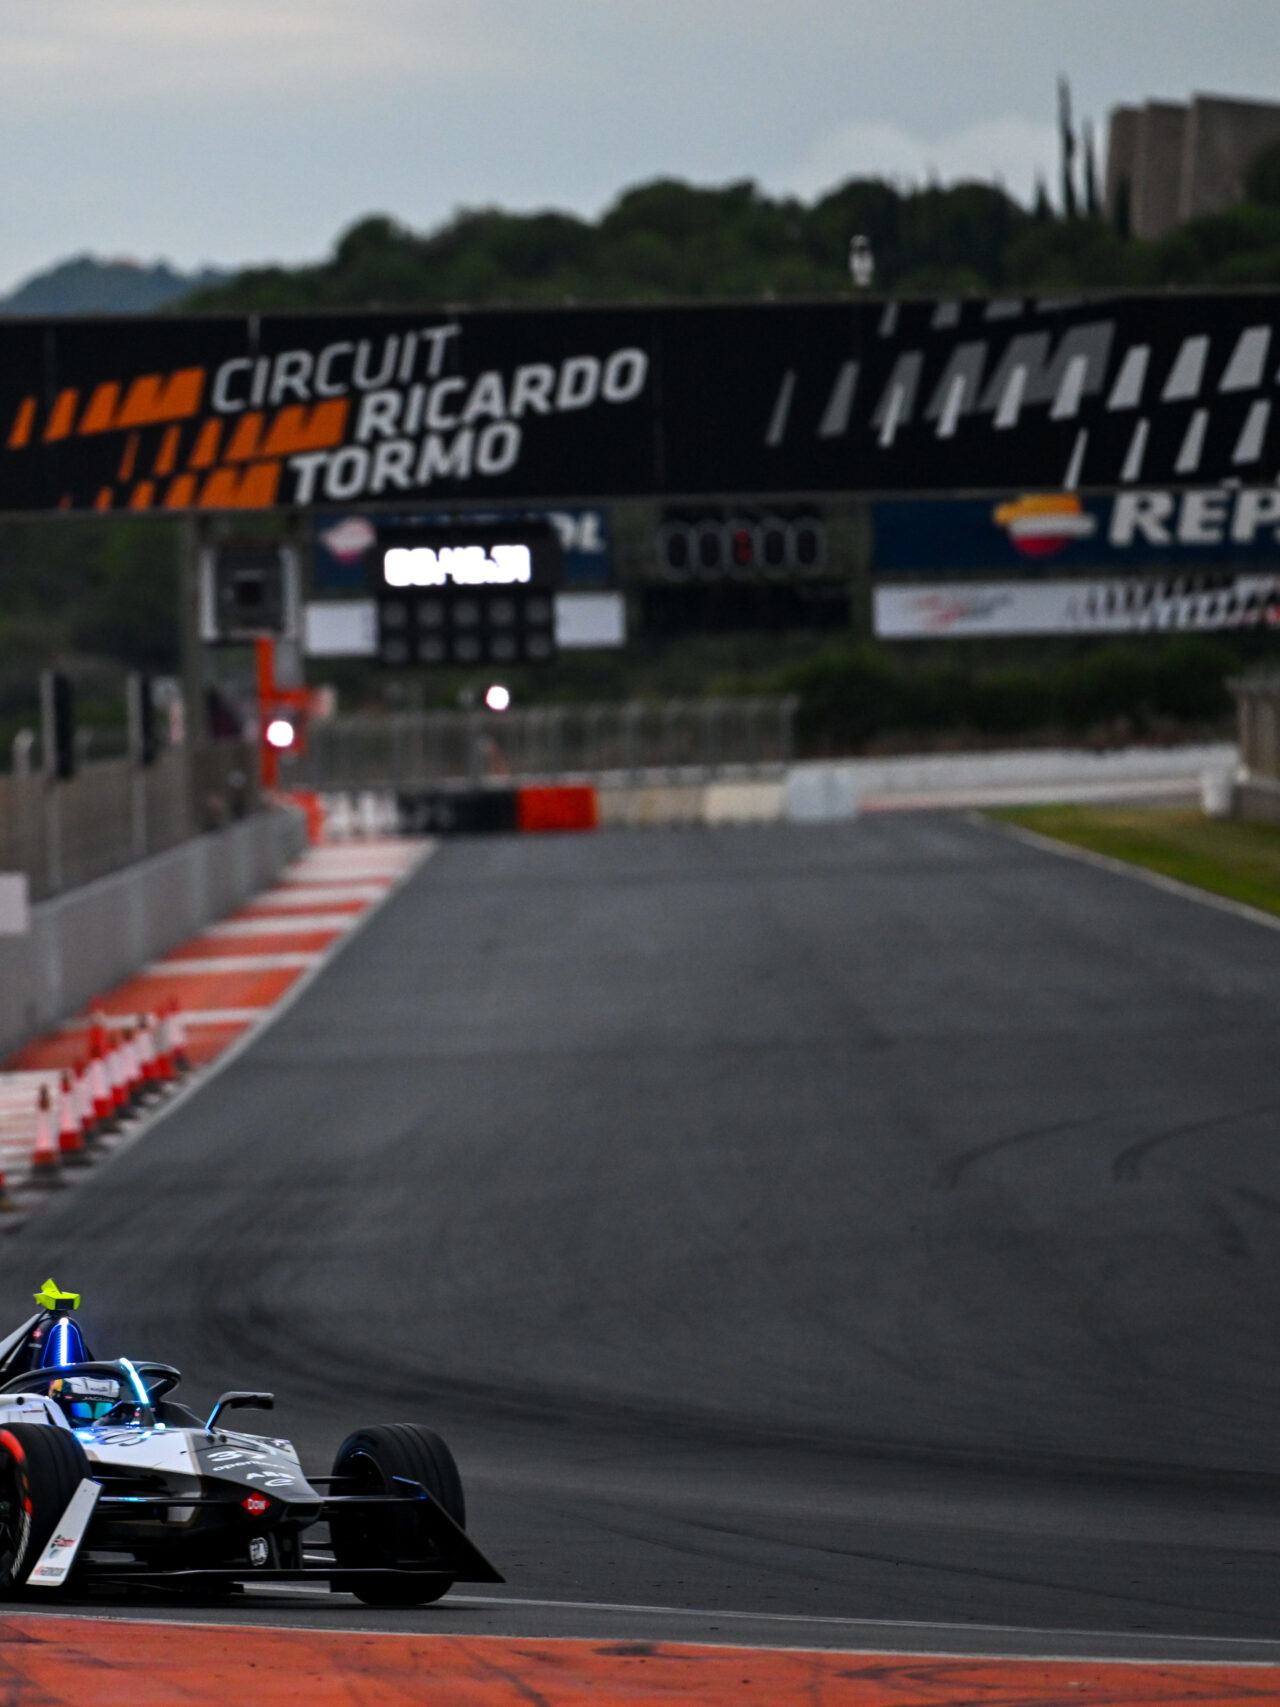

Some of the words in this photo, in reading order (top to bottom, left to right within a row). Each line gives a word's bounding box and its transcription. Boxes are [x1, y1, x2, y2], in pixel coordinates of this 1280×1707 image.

[212, 325, 462, 413] CIRCUIT
[356, 348, 648, 443] RICARDO
[290, 421, 521, 506] TORMO
